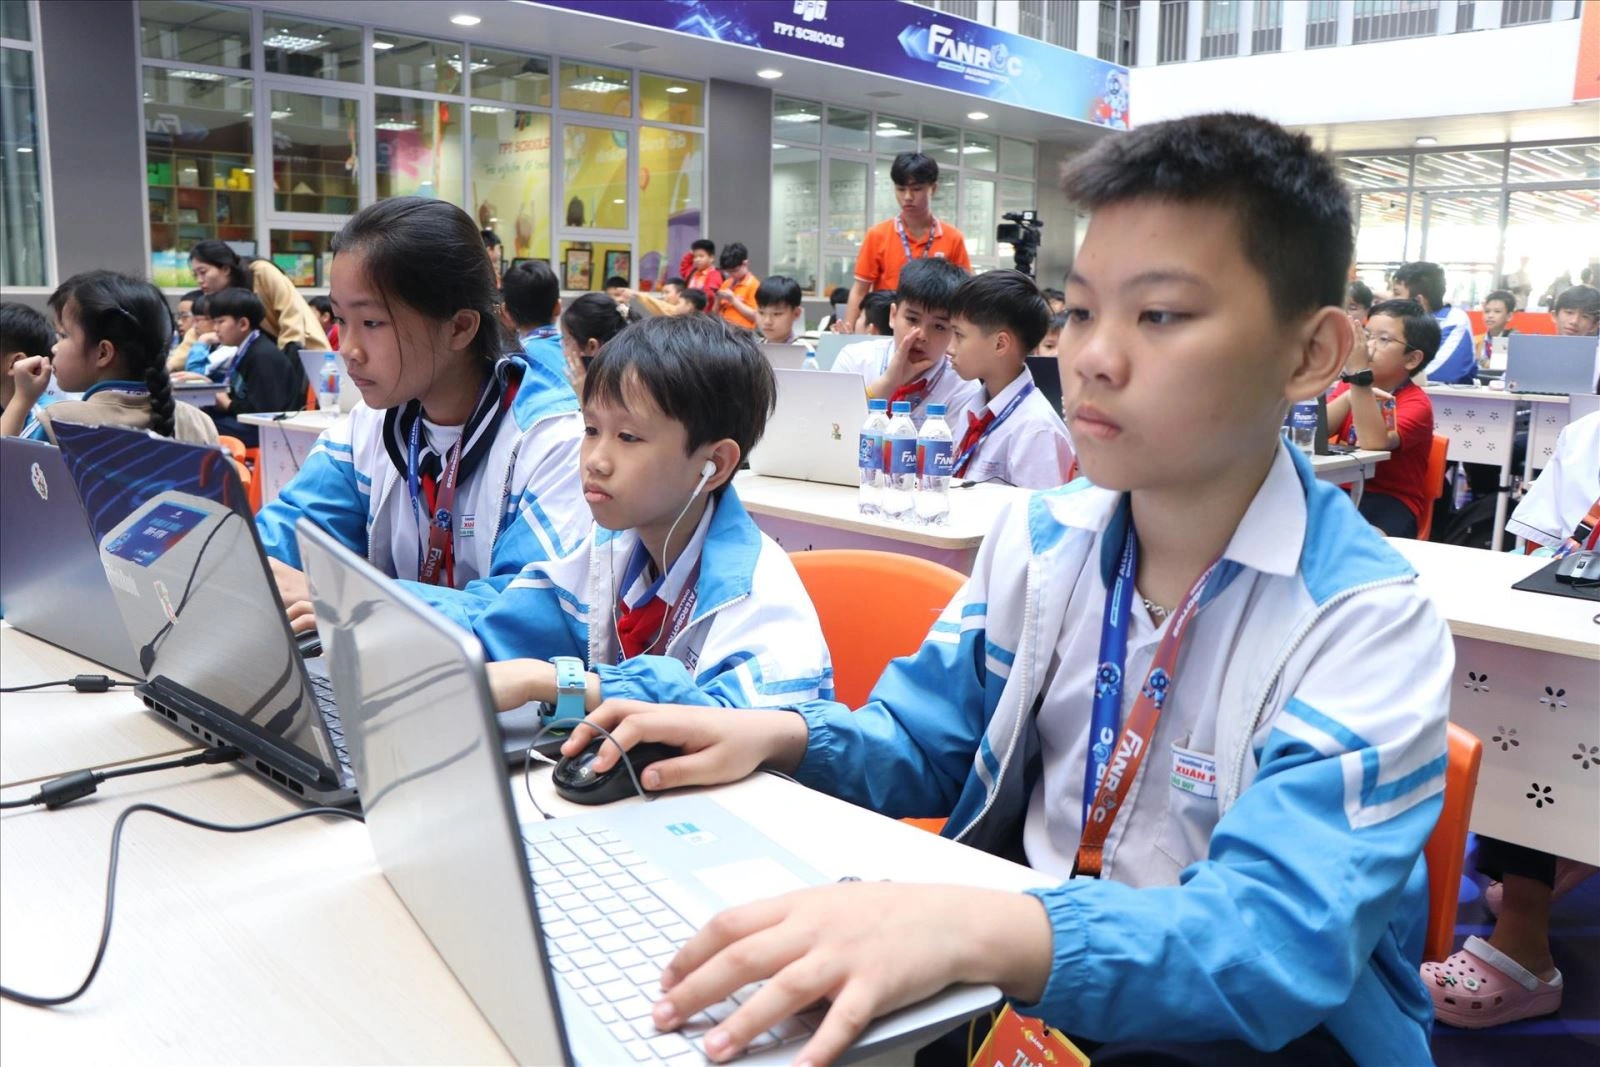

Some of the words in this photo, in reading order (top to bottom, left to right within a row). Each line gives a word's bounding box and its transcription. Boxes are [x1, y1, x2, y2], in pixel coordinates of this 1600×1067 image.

[773, 21, 795, 37] FPT
[794, 26, 845, 48] SCHOOLS
[927, 23, 1024, 77] FANROC
